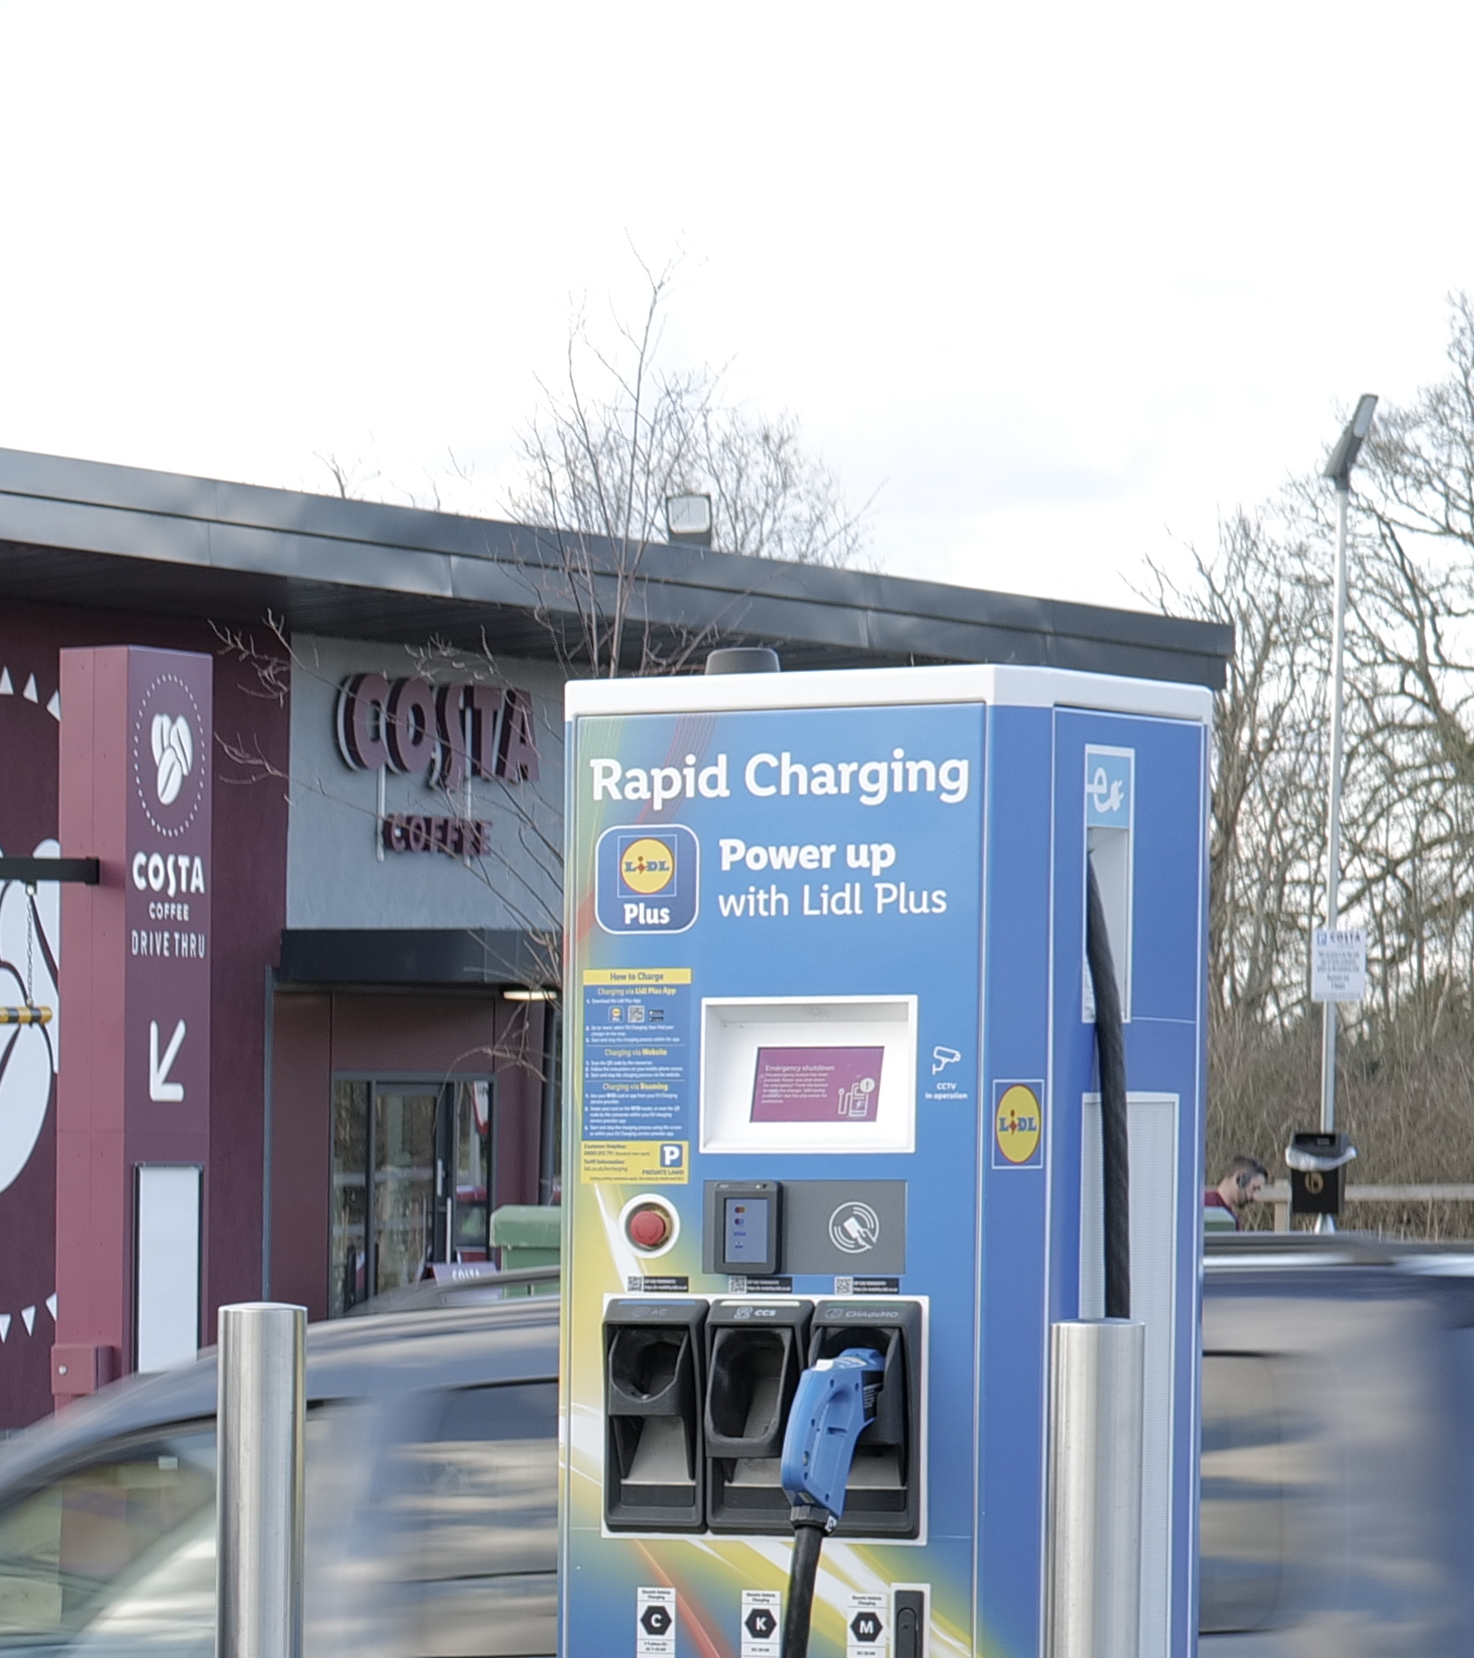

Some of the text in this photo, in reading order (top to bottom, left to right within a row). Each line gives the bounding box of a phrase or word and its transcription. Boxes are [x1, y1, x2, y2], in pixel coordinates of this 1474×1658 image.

[339, 672, 540, 792] COSTA
[590, 749, 970, 810] Rapid Charging
[384, 813, 494, 857] COFFEE
[719, 838, 896, 876] Power up
[132, 851, 206, 898] COSTA
[718, 881, 947, 918] with Lidl Plus
[148, 902, 190, 922] COFFEE
[623, 902, 671, 926] Plus
[131, 929, 206, 960] DRIVE THRU
[610, 971, 664, 982] How to Charge
[765, 1065, 801, 1073] Emergency
[933, 1092, 968, 1101] operation
[936, 1082, 957, 1091] CCTV
[663, 1145, 680, 1166] P
[754, 1309, 776, 1317] CCS
[651, 1613, 663, 1628] C
[755, 1616, 767, 1631] K
[859, 1620, 874, 1634] M
